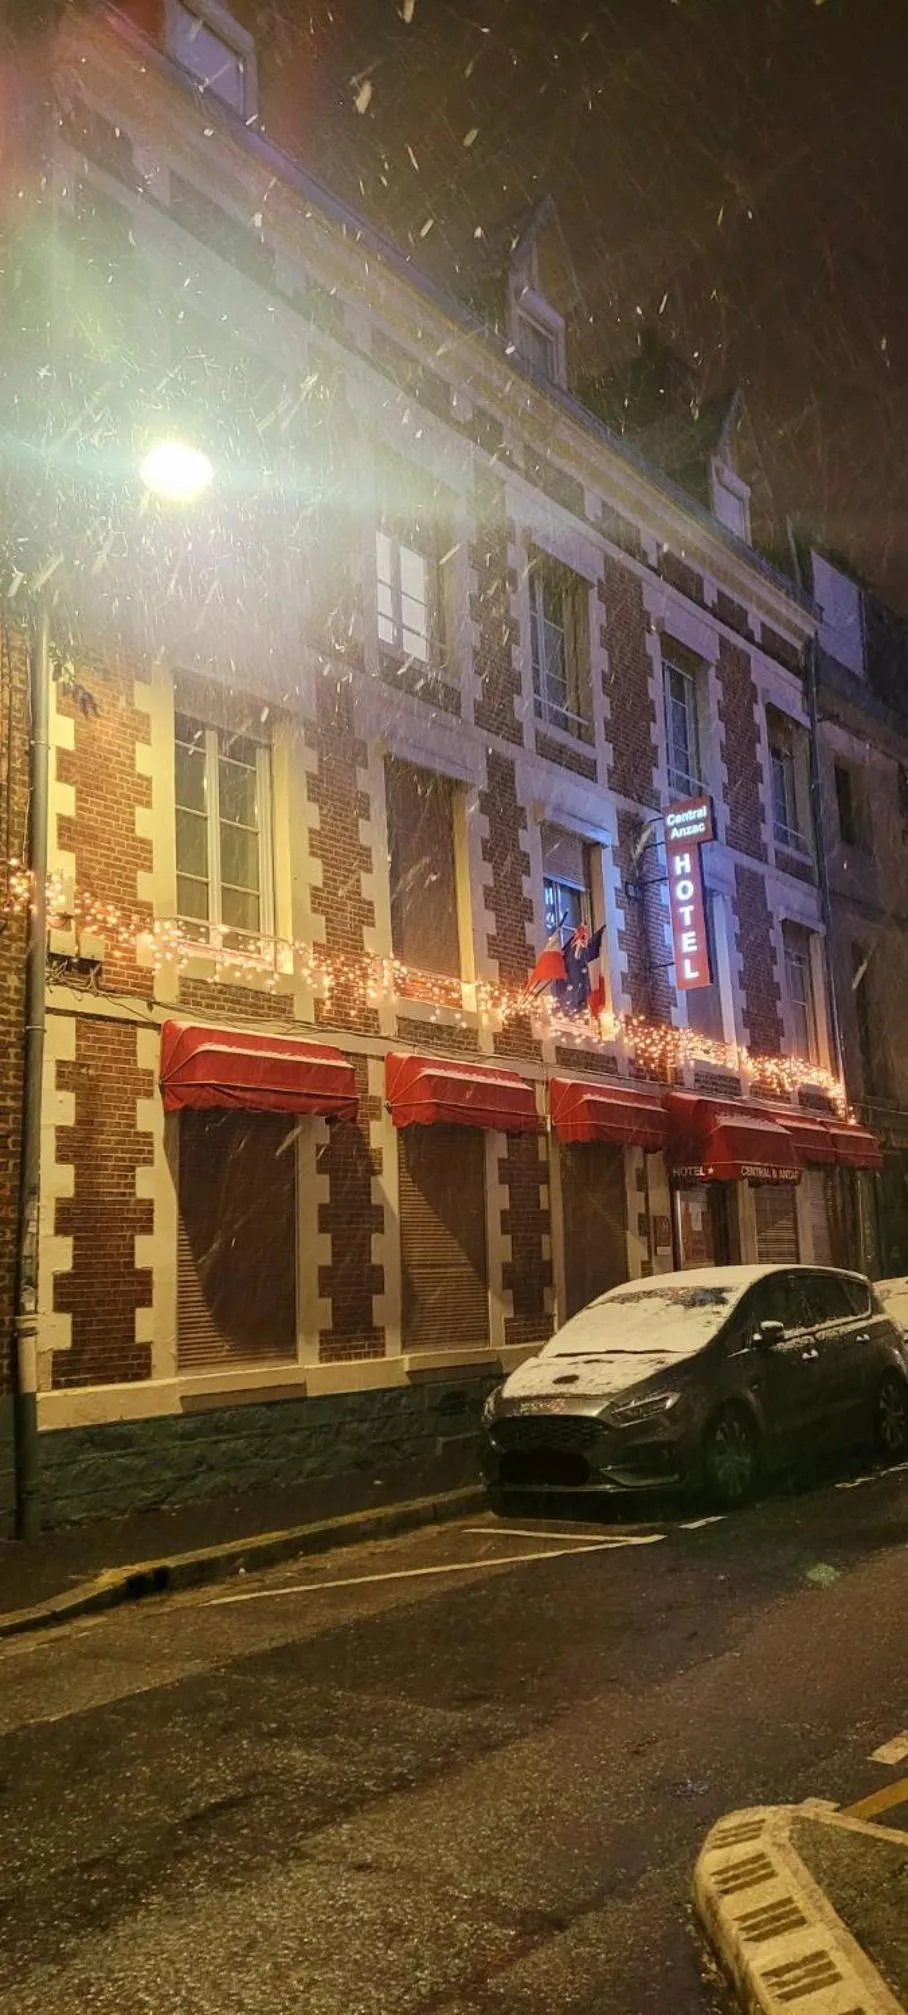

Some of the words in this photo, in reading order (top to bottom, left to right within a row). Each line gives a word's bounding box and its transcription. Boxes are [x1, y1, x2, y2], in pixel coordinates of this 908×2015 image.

[666, 806, 707, 827] Central
[670, 822, 706, 839] Anzac
[674, 852, 700, 980] HOTEL
